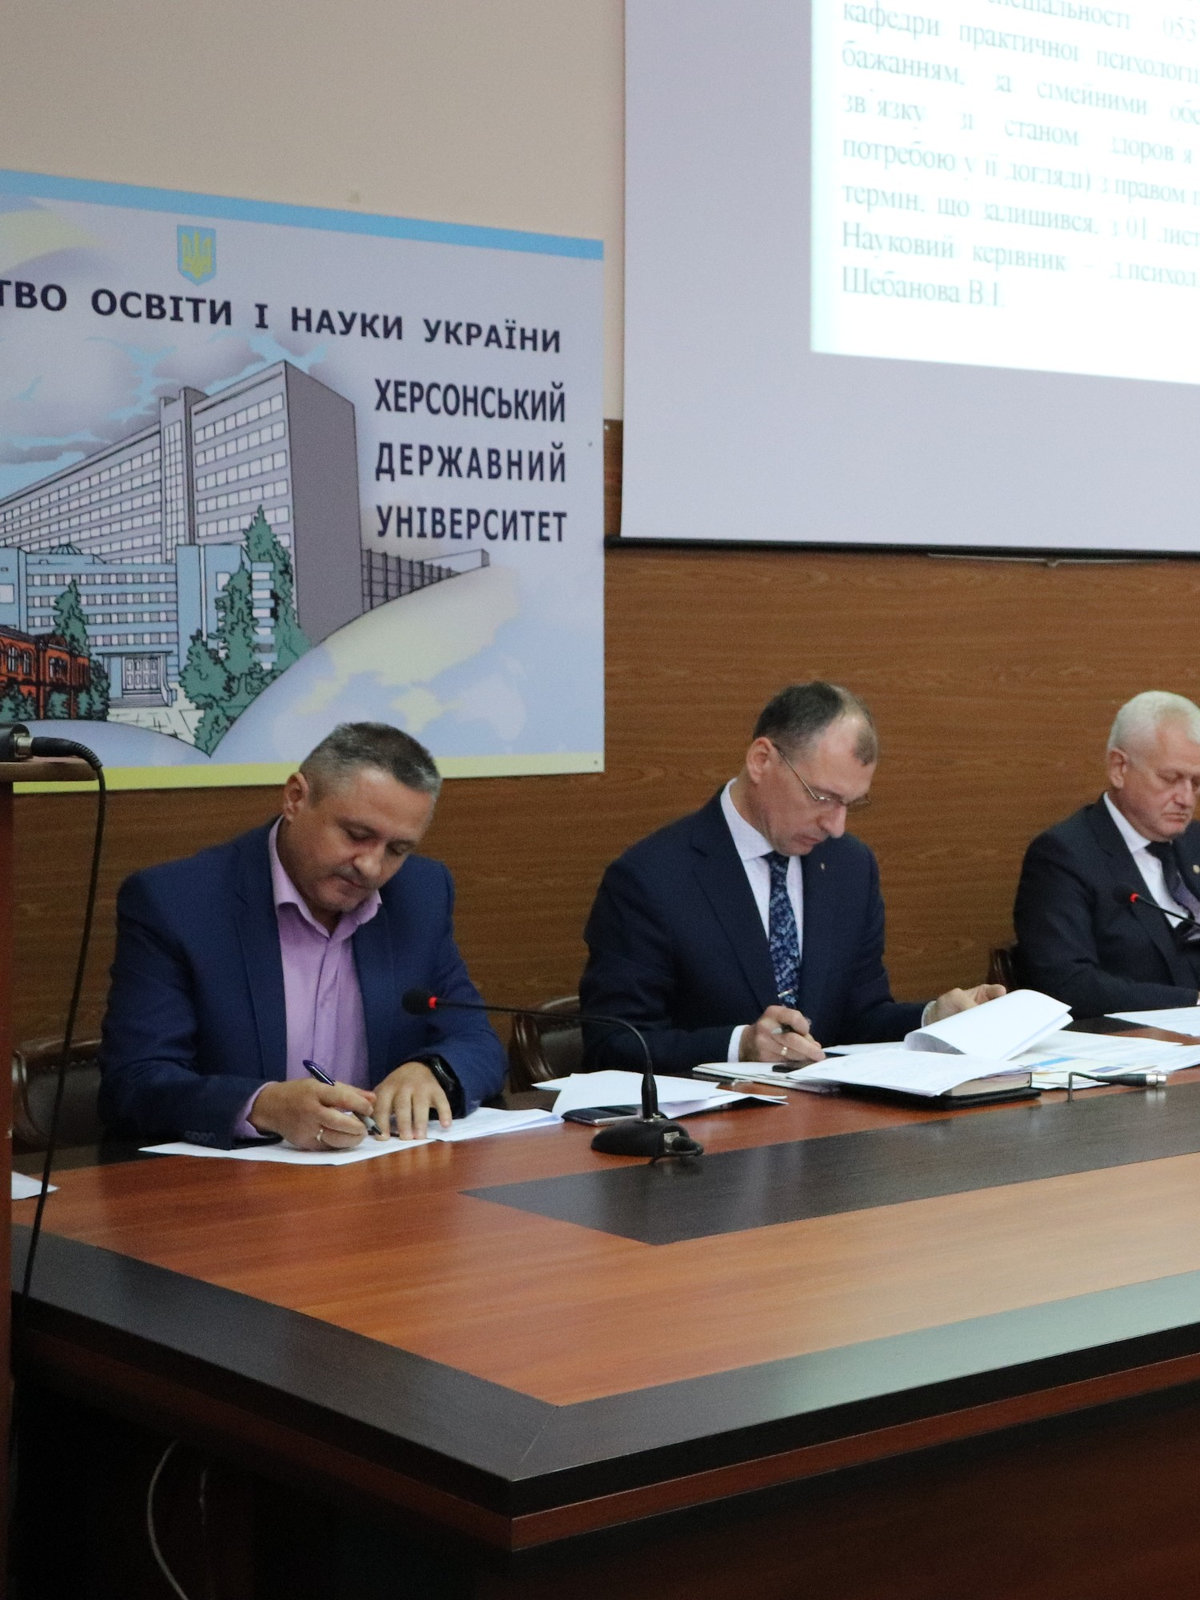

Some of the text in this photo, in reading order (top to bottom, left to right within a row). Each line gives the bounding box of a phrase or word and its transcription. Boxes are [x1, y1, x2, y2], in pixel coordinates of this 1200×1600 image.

[842, 0, 941, 40] кафедри
[1035, 80, 1149, 116] сімейними
[1004, 119, 1080, 147] станом
[842, 138, 958, 173] потребою
[1114, 178, 1186, 205] правом
[842, 221, 955, 260] Науковий
[972, 244, 1067, 273] керівник
[91, 287, 232, 326] ОСВІТИ
[254, 303, 269, 329] І
[291, 306, 403, 340] НАУКИ
[423, 318, 561, 353] УКРАЇНИ
[374, 378, 566, 422] ХЕРСОНСЬКИЙ
[375, 441, 566, 482] ДЕРЖАВНИЙ
[376, 505, 567, 542] УНІВЕРСИТЕТ
